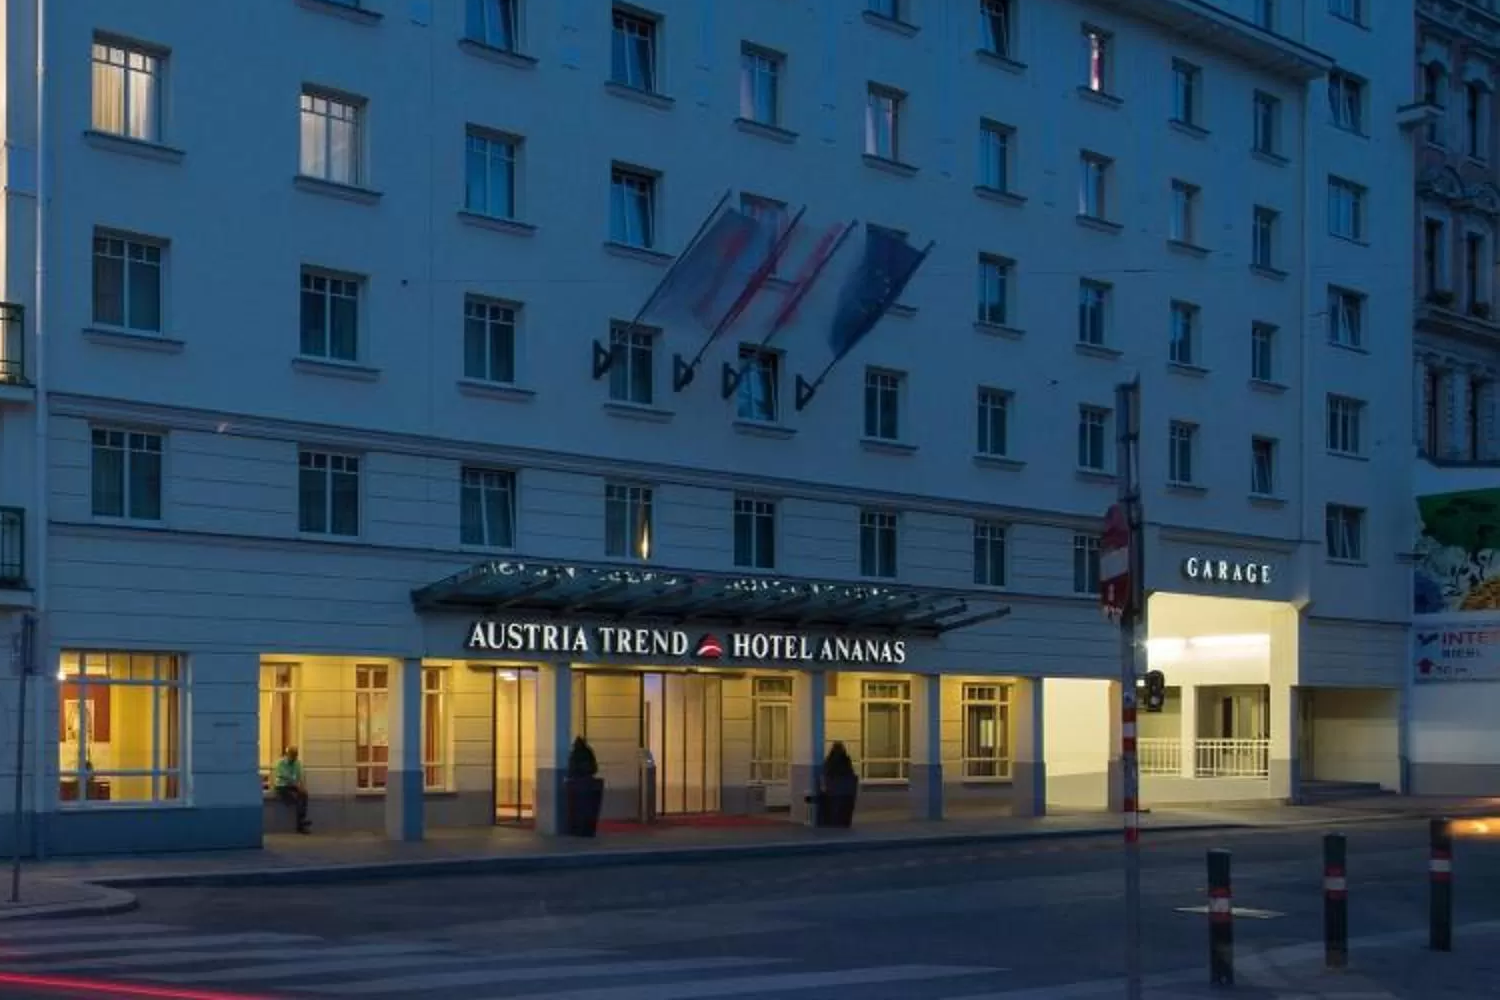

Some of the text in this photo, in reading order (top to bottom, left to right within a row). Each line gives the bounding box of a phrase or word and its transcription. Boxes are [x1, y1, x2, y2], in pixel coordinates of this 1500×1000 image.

[1186, 556, 1271, 584] GARAGE
[469, 621, 906, 664] AUSTRIA TREND HOTEL ANANAS
